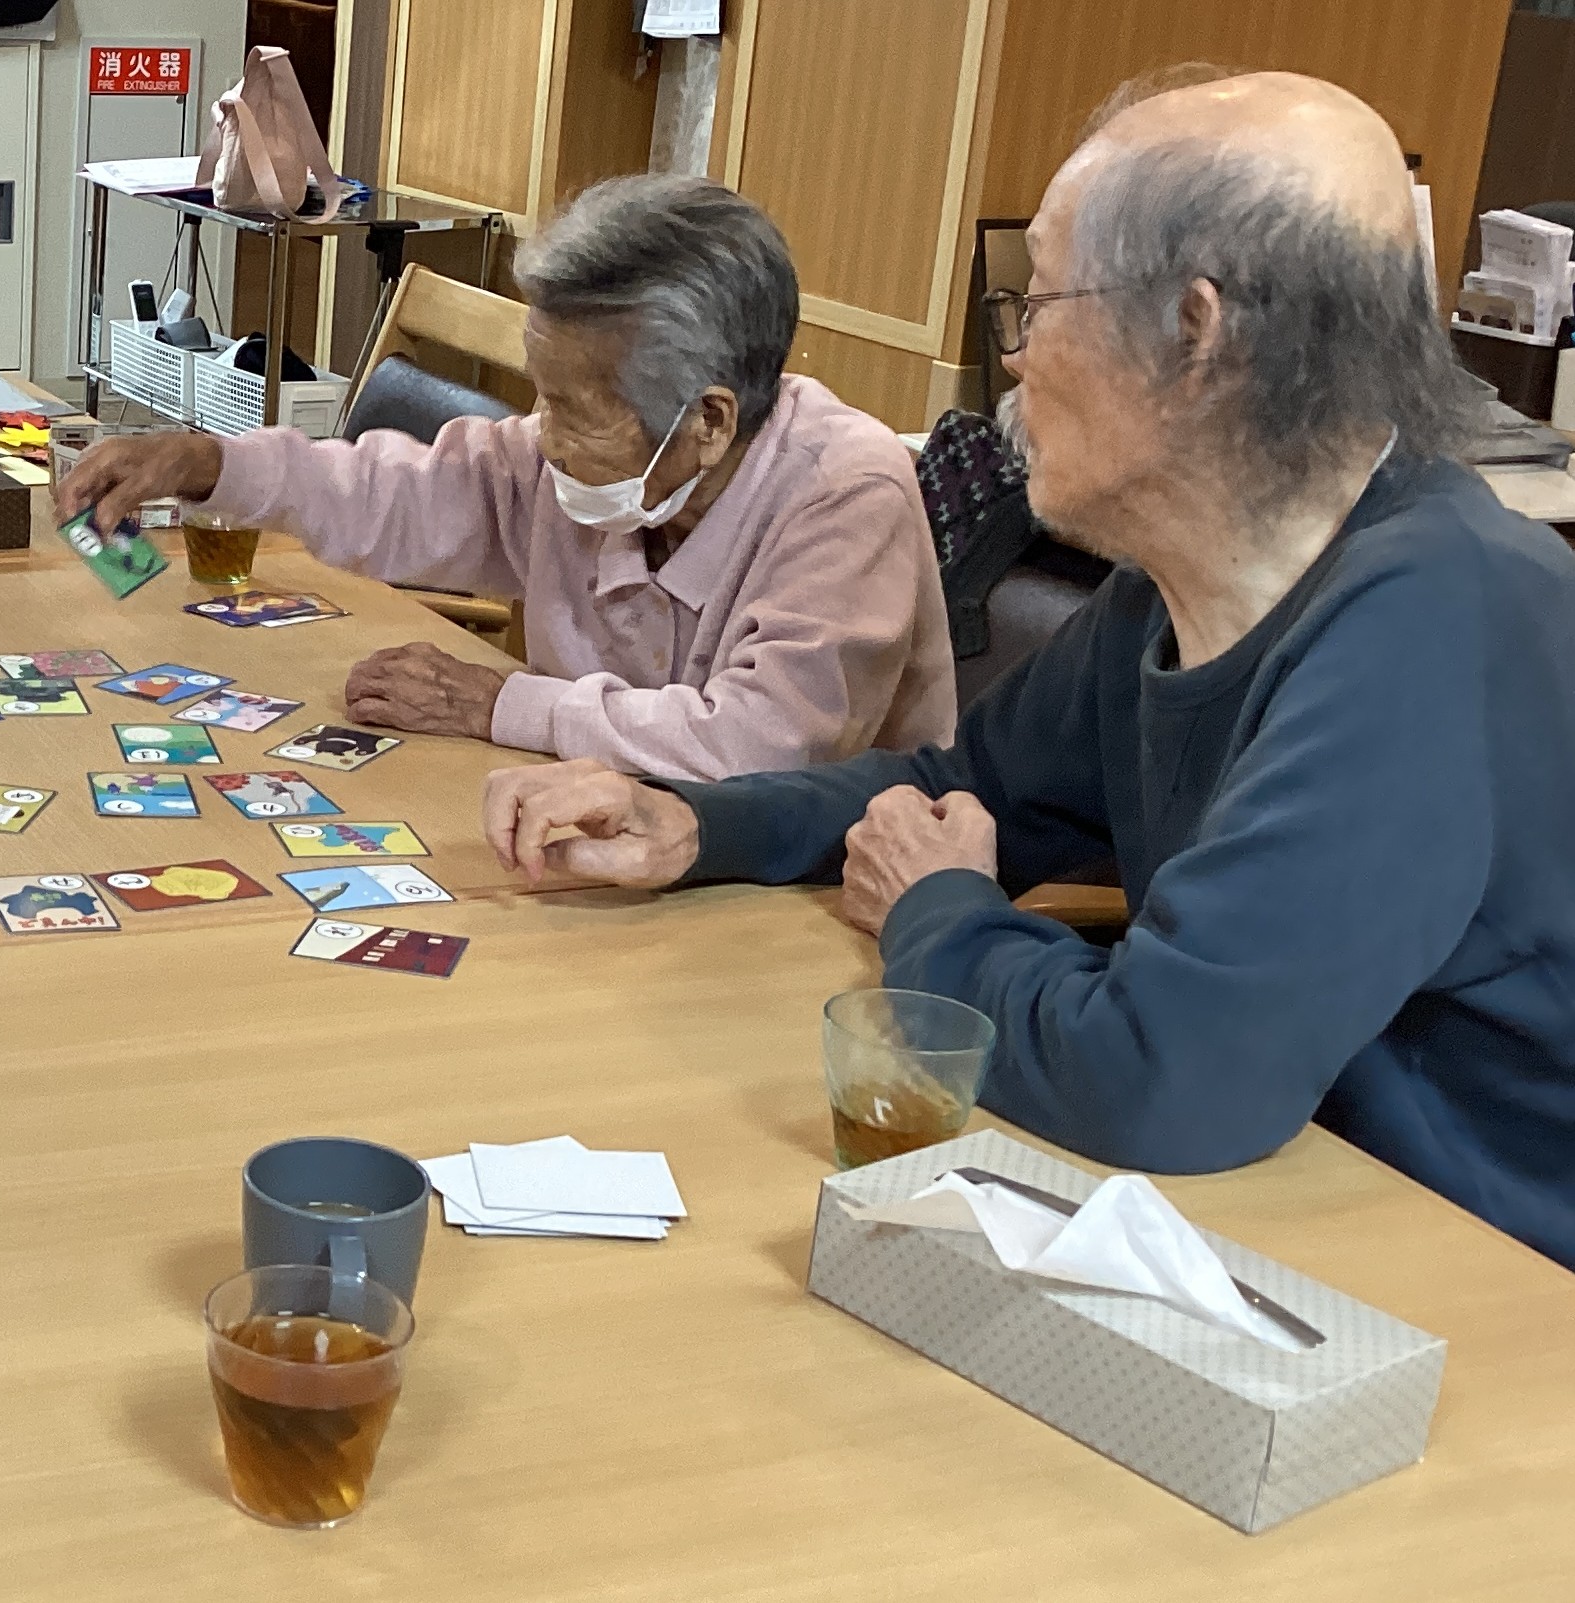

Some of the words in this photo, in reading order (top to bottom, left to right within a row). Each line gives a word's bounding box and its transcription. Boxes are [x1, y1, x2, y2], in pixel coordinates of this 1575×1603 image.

[98, 51, 181, 78] 消火器
[97, 80, 116, 90] FIRE
[123, 80, 181, 91] EXTINGUISHER
